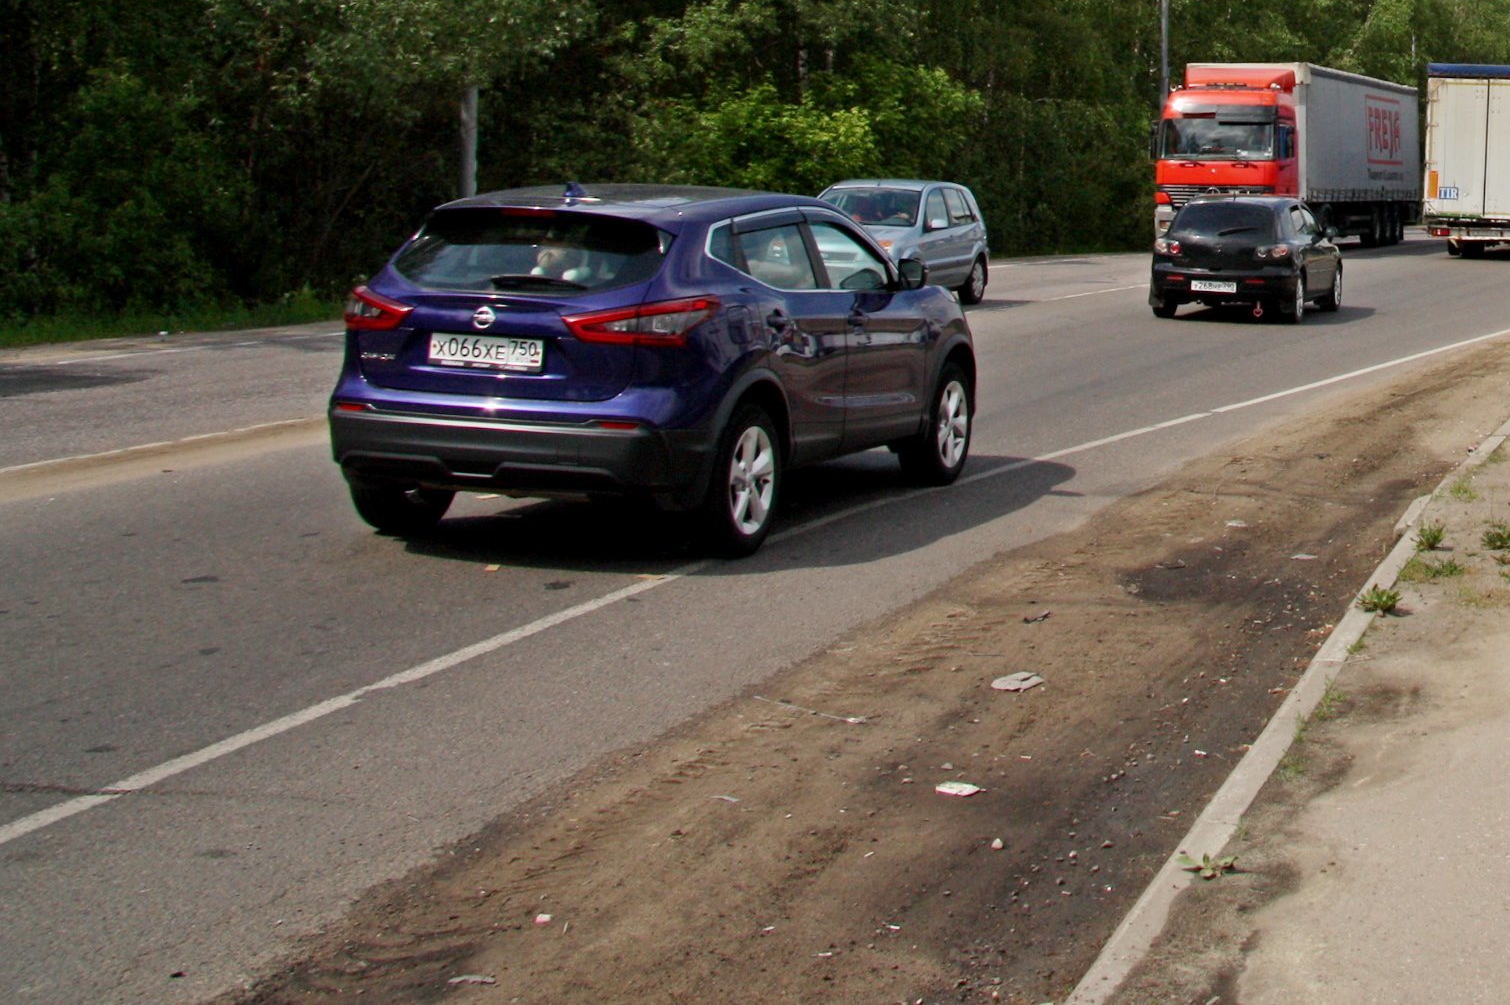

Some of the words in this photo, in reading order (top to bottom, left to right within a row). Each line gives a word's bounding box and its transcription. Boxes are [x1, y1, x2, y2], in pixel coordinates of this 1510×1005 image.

[1366, 106, 1401, 159] FREJA
[1439, 187, 1459, 199] TIR
[510, 340, 538, 357] 750
